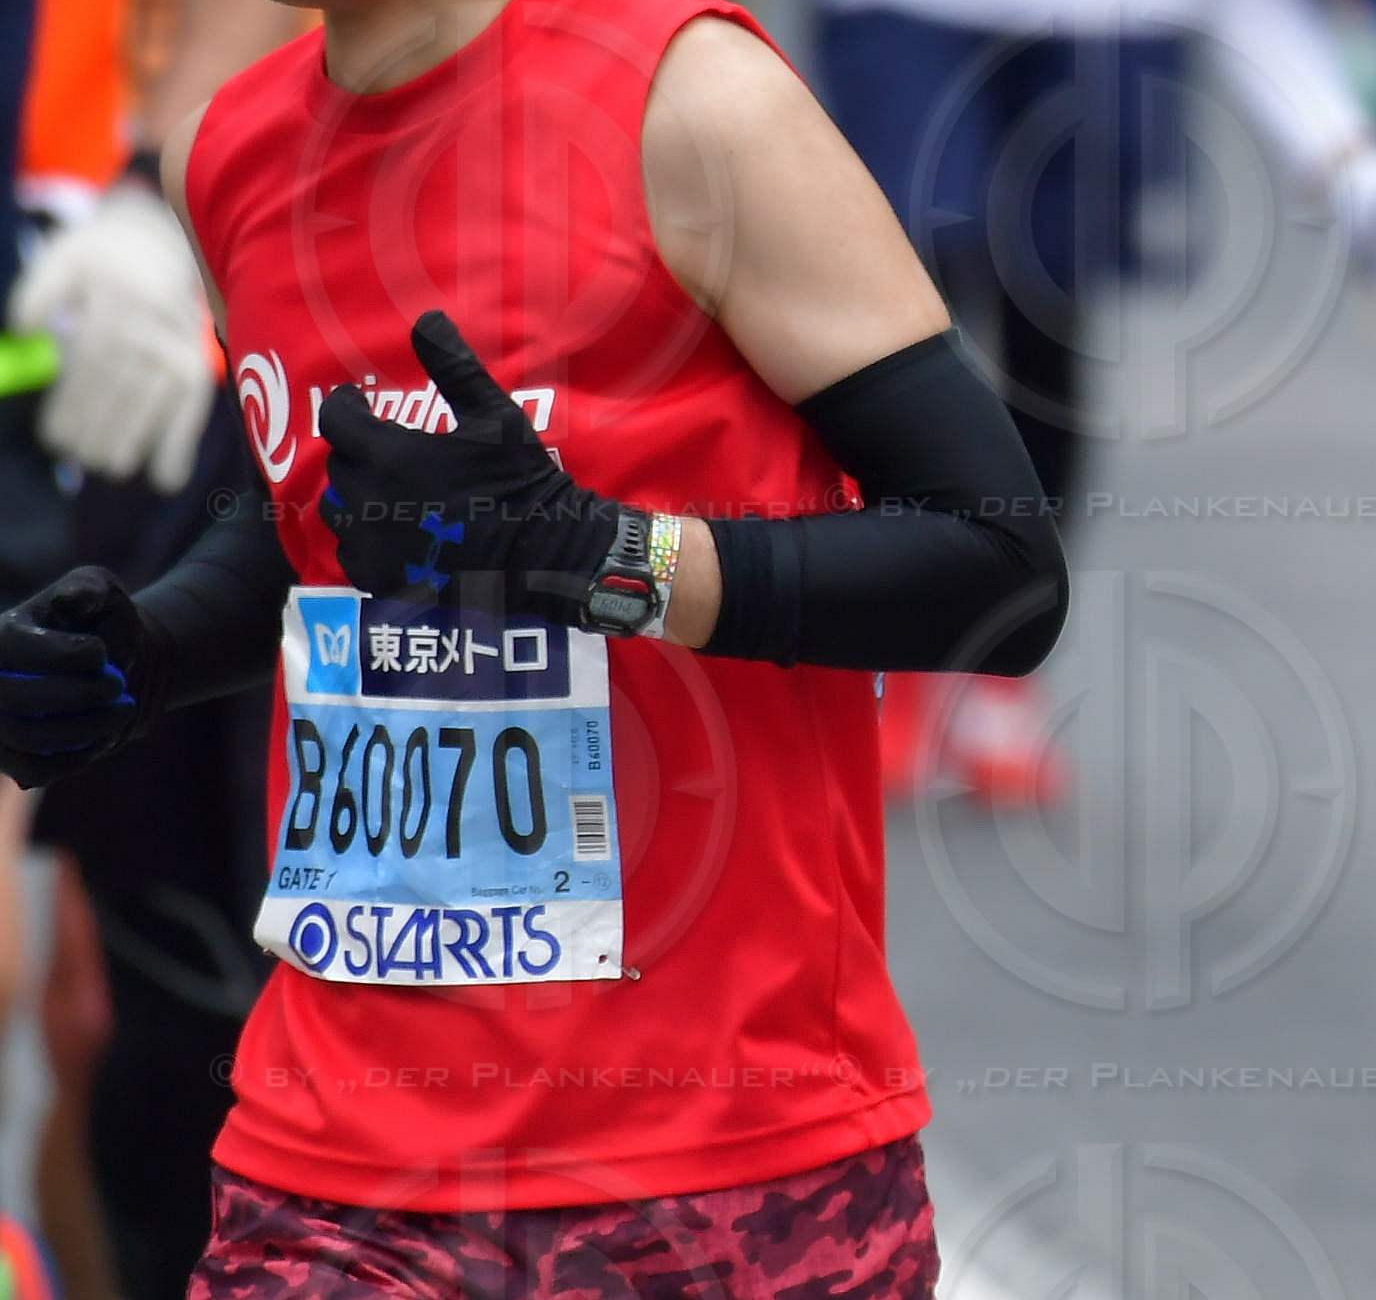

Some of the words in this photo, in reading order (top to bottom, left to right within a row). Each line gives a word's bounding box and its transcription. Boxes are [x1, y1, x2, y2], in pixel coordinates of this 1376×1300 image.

[367, 621, 549, 675] 東京メトロ
[587, 719, 601, 771] B60070
[284, 718, 548, 860] B60070
[278, 866, 325, 891] GATE
[325, 869, 338, 891] 1
